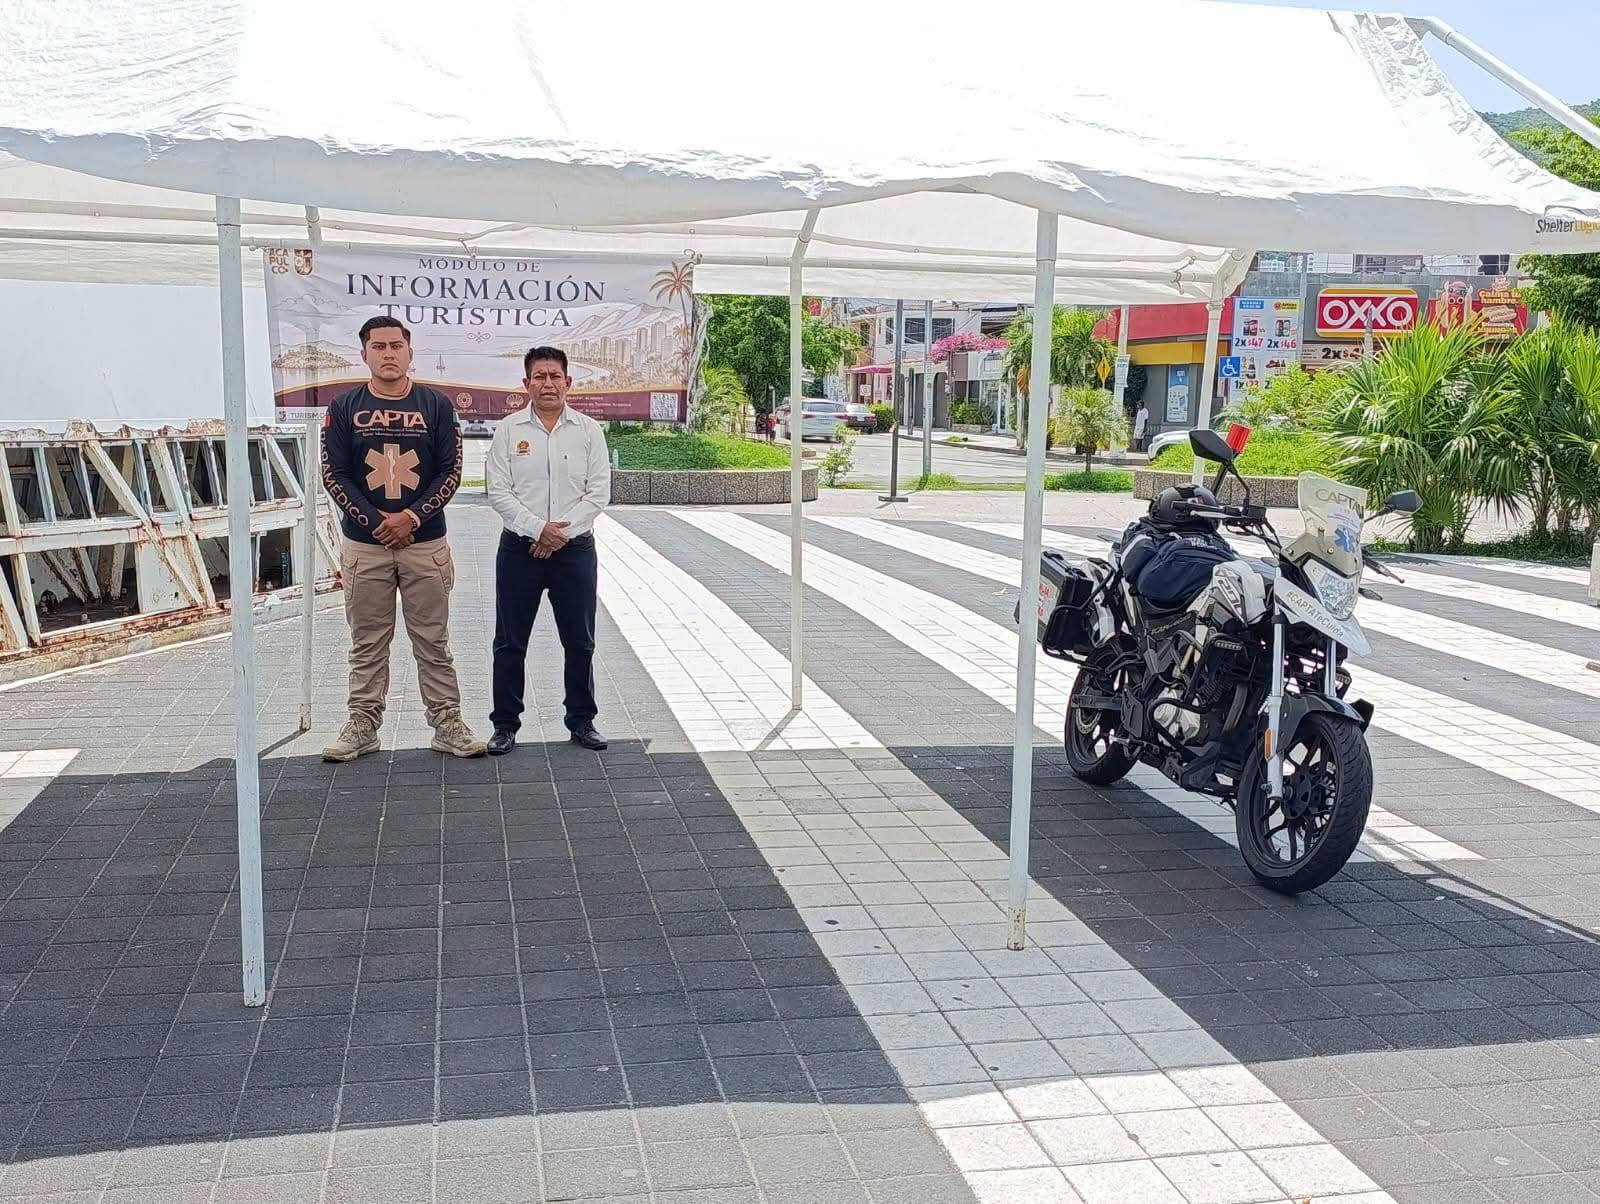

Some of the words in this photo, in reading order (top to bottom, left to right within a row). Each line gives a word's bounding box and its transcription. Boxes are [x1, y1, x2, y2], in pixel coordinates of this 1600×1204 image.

[269, 249, 289, 257] ACA
[269, 256, 289, 265] PUL
[418, 257, 506, 272] MÓDULO
[516, 262, 541, 273] DE
[346, 273, 606, 302] INFORMACIÓN
[379, 302, 572, 327] TURÍSTICA
[1322, 296, 1413, 329] OXXO
[1234, 338, 1247, 347] 2x
[1267, 339, 1279, 349] 2x
[1321, 347, 1341, 360] 2x
[353, 409, 429, 429] CAPTA
